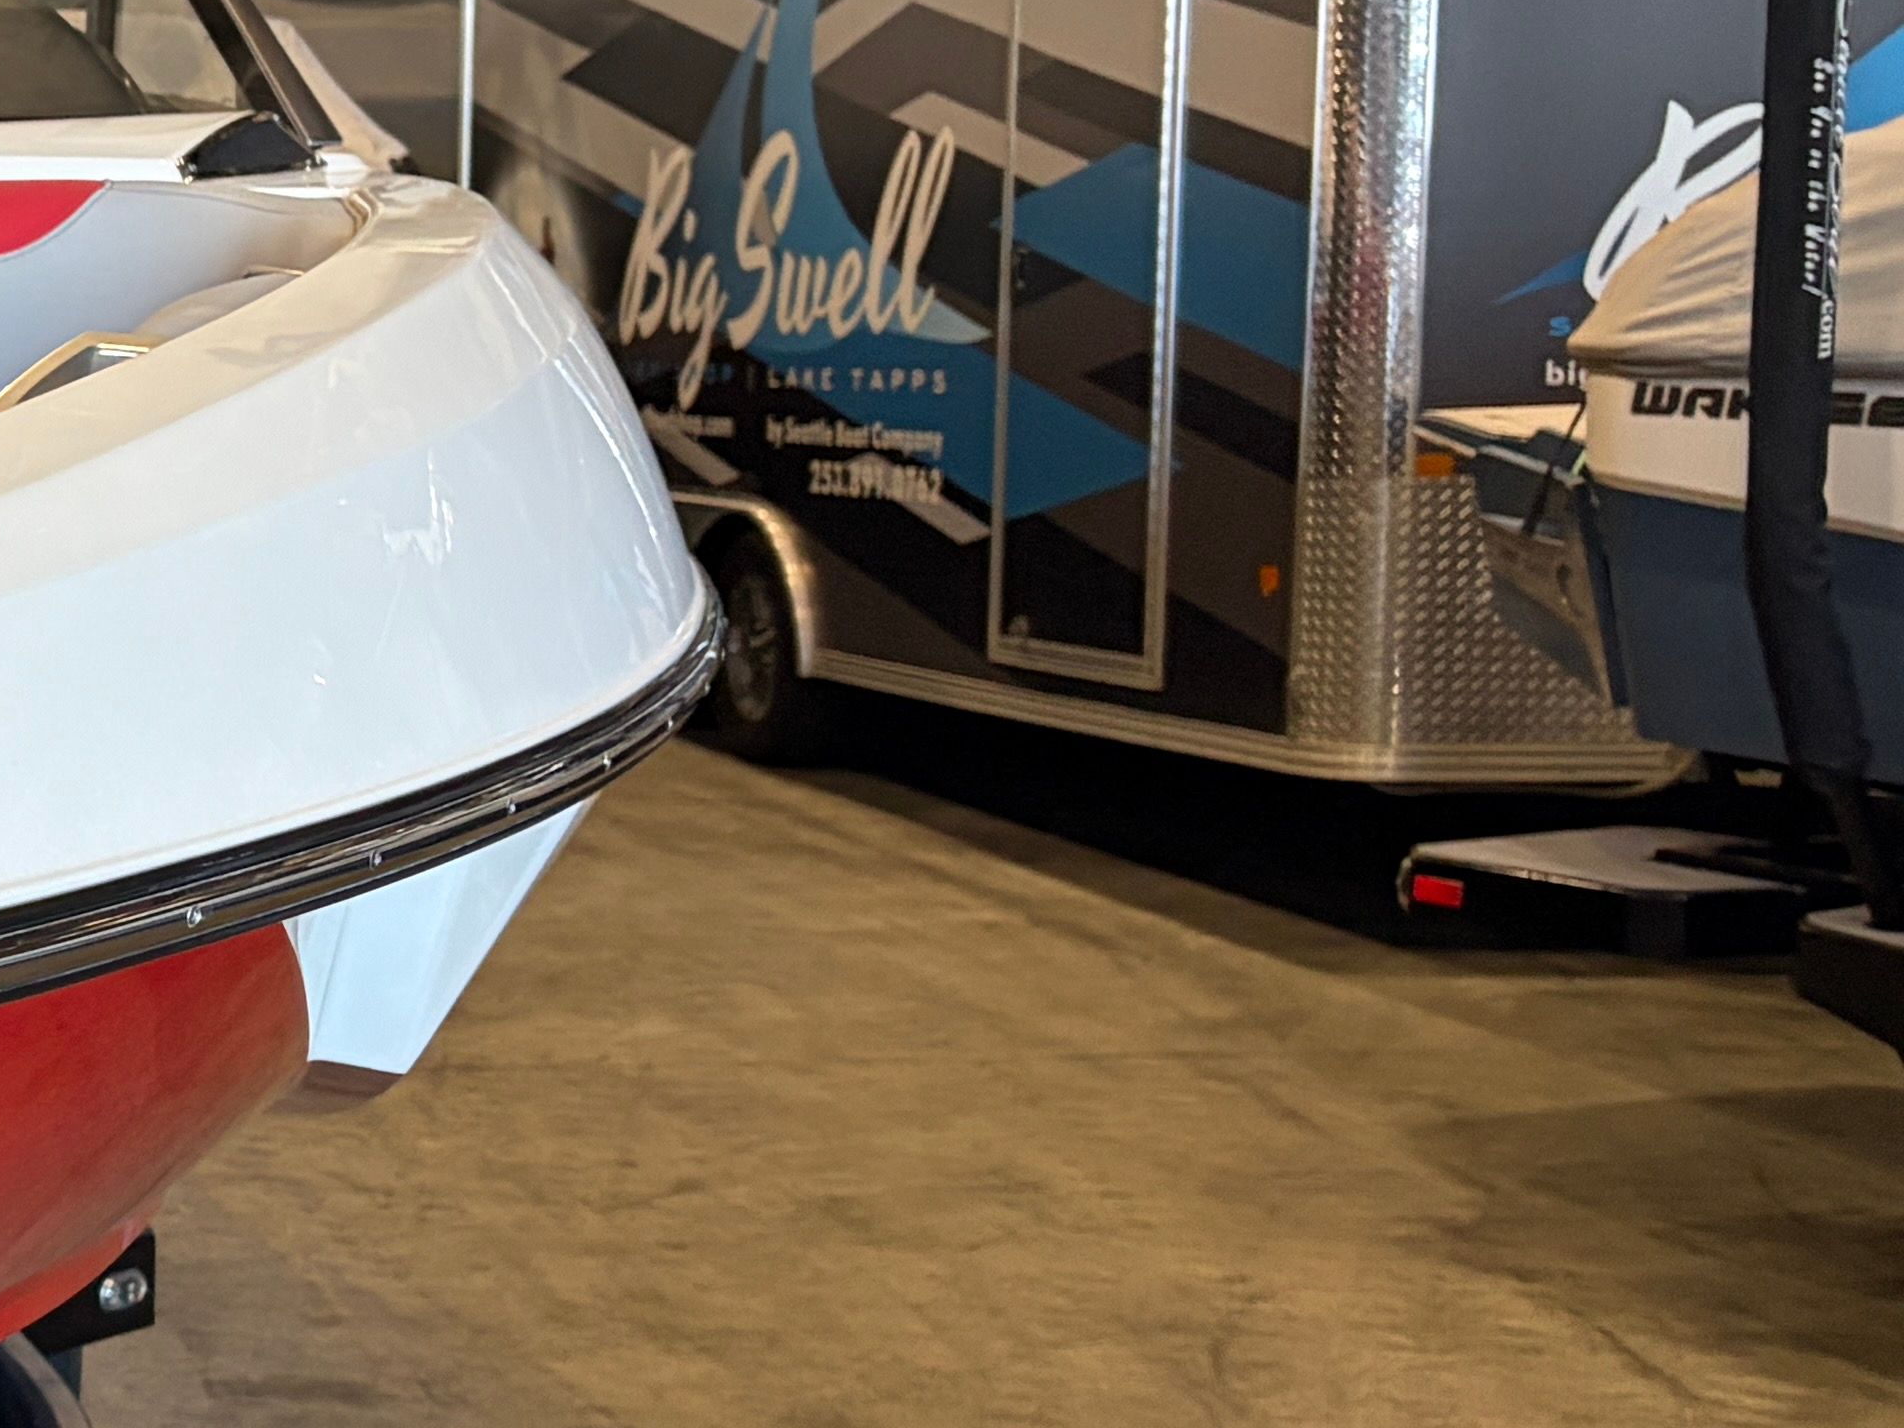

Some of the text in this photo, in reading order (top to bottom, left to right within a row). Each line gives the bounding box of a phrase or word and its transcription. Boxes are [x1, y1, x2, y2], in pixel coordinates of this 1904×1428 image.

[618, 124, 955, 413] Big Swell
[850, 367, 948, 396] TAPPS
